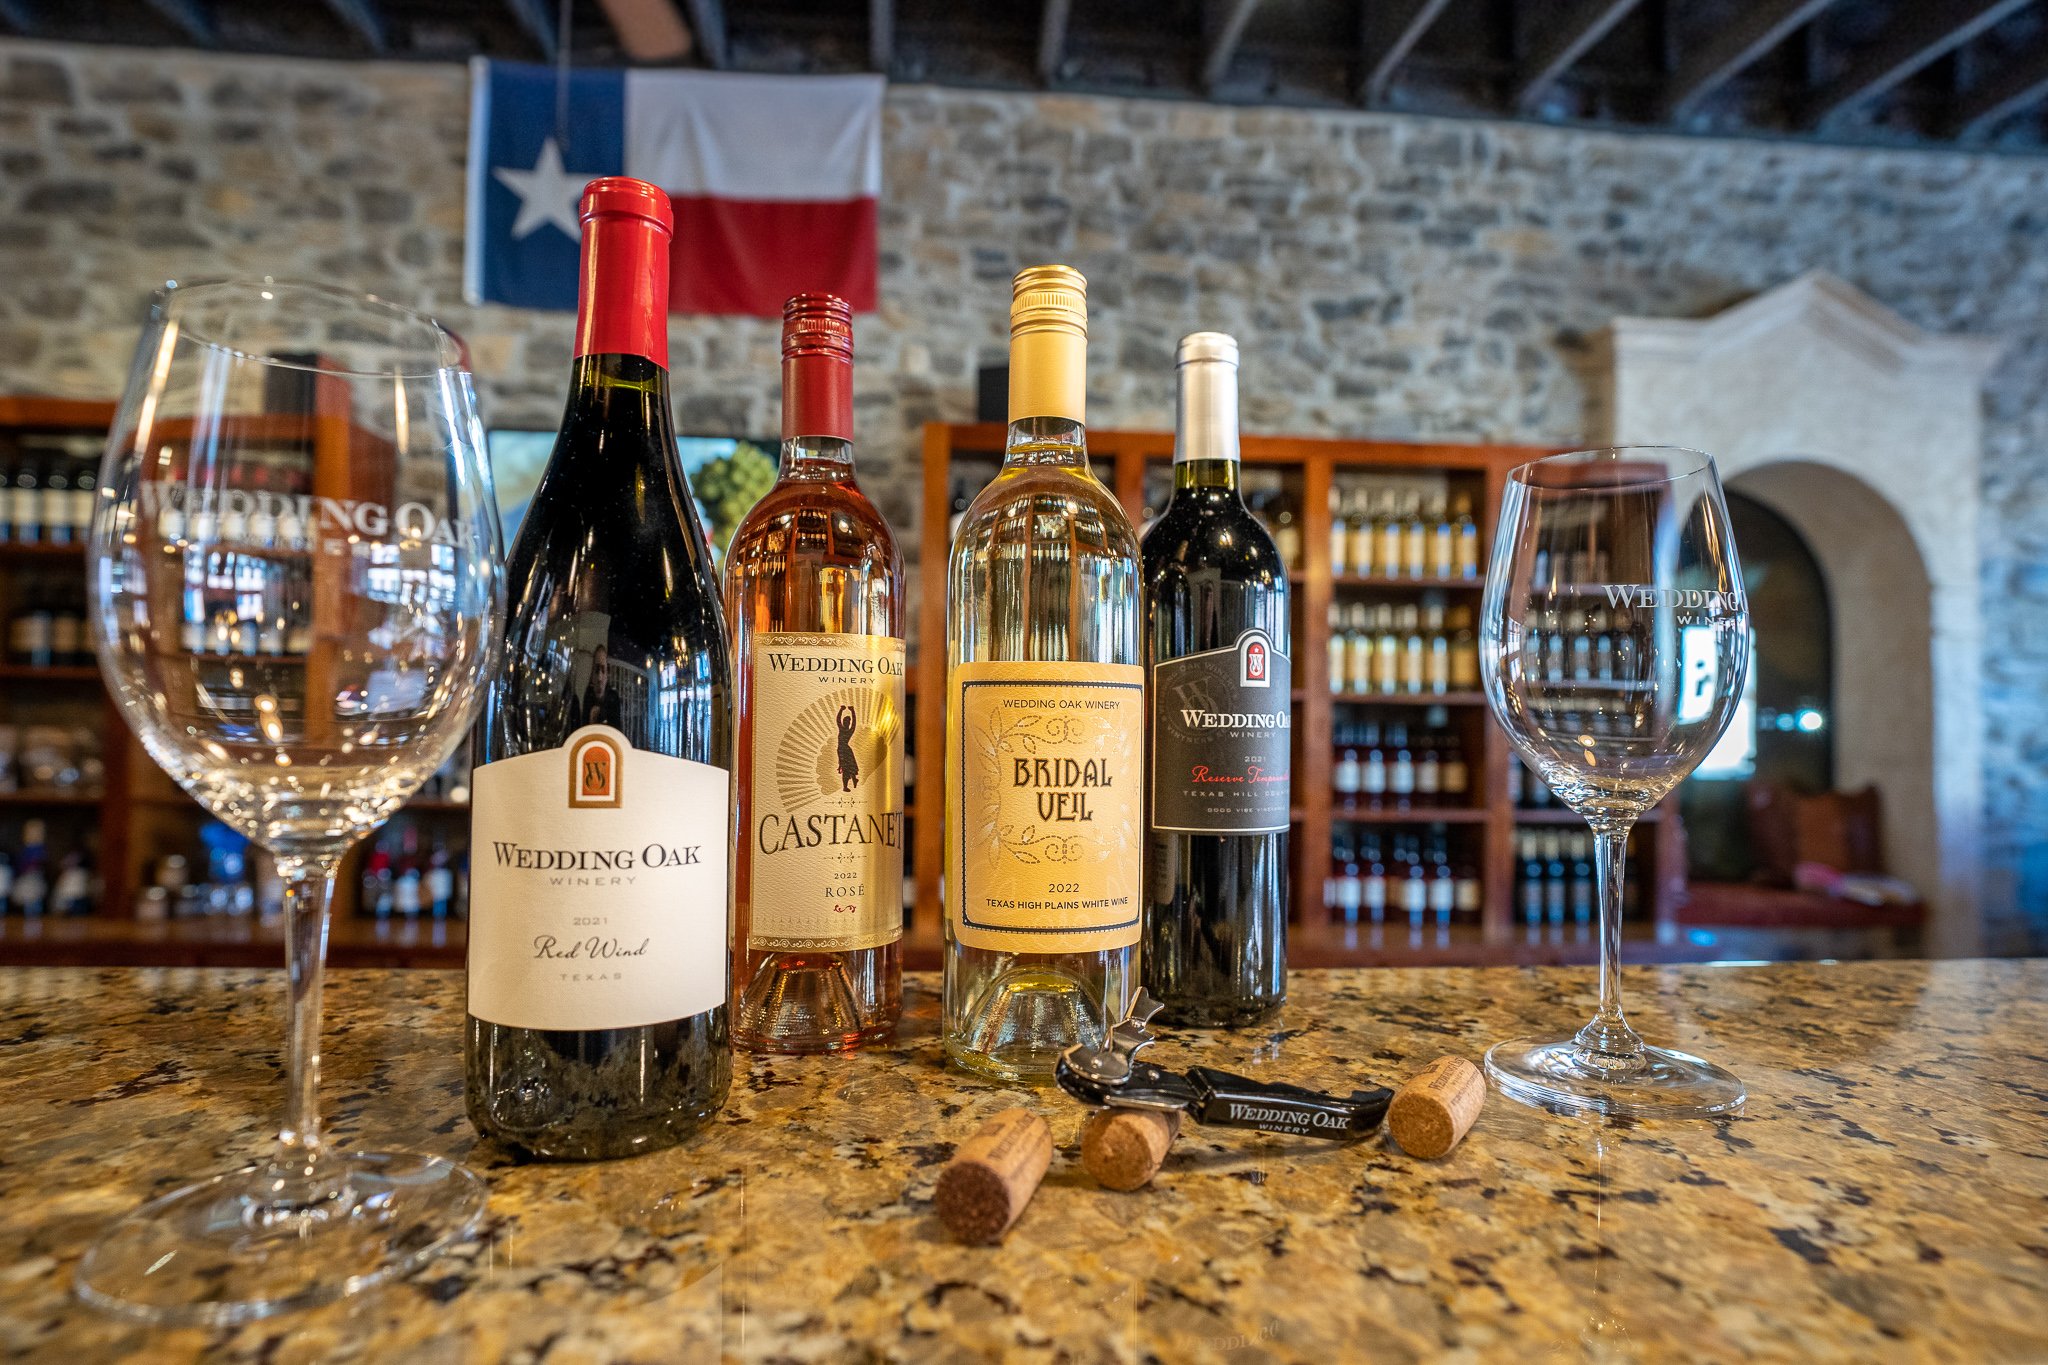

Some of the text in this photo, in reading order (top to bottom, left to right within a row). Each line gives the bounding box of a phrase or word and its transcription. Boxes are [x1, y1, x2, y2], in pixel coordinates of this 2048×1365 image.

[394, 500, 475, 549] OAK
[1601, 584, 1740, 612] WEDDING
[768, 653, 903, 676] WEDDING OAK
[818, 676, 876, 684] WINERY
[1003, 699, 1121, 710] WEDDING OAK WINERY
[1180, 709, 1275, 728] WEDDING
[1012, 757, 1113, 788] BRIDAL
[1191, 765, 1245, 783] Reserve
[1036, 791, 1094, 822] VEIL
[492, 840, 702, 871] WEDDING OAK
[549, 876, 638, 887] WINERY
[834, 872, 858, 880] 2022
[825, 884, 865, 898] ROSÉ
[1048, 882, 1080, 893] 2022
[986, 896, 1129, 910] TEXAS HIGH PLAINS WHITE WINE
[572, 917, 609, 926] 2021
[533, 935, 650, 960] Red Wind
[559, 973, 623, 982] TEXAS
[1229, 1103, 1351, 1129] WEDDING OAK
[1258, 1123, 1311, 1135] WINERY
